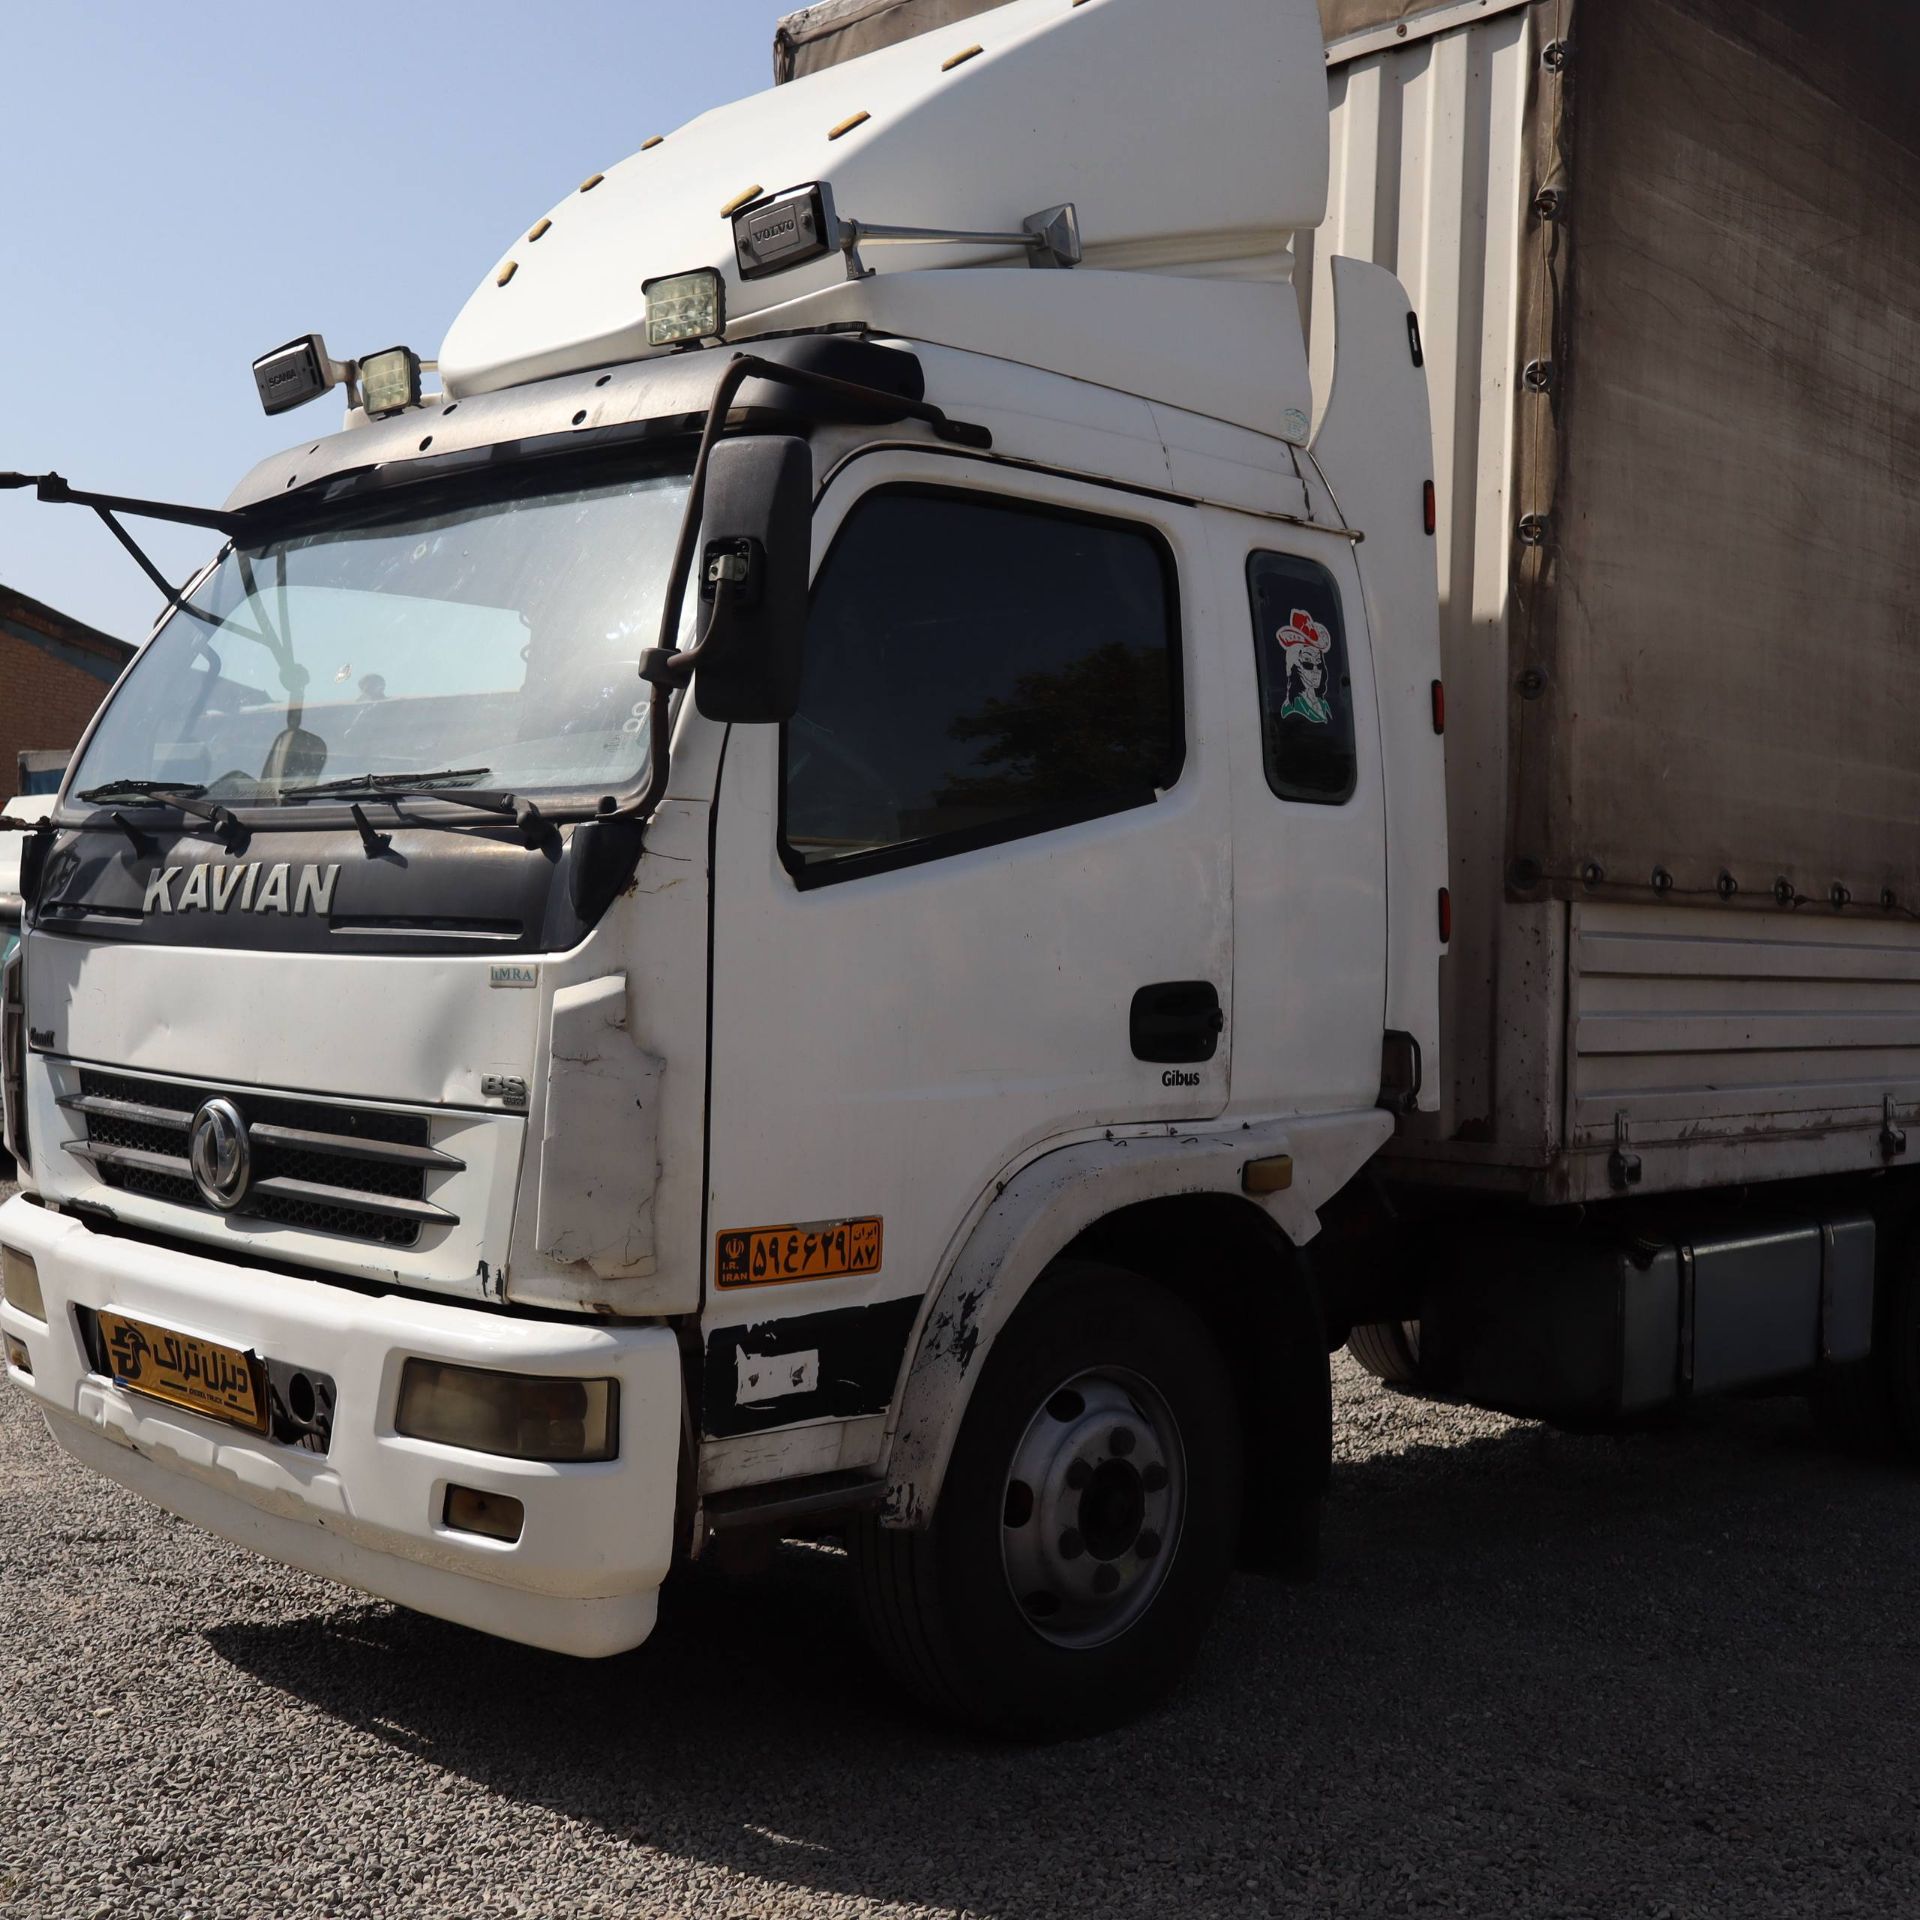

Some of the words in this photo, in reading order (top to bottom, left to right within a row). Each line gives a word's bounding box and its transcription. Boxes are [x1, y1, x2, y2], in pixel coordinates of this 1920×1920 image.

[753, 219, 795, 243] VOLVO
[268, 368, 298, 388] SCANIA
[142, 862, 341, 914] KAVIAN
[1161, 1069, 1200, 1087] Gibus
[853, 1226, 877, 1242] ایران
[722, 1261, 739, 1270] I.R.
[852, 1244, 876, 1268] ۸۷
[722, 1272, 748, 1282] IRAN
